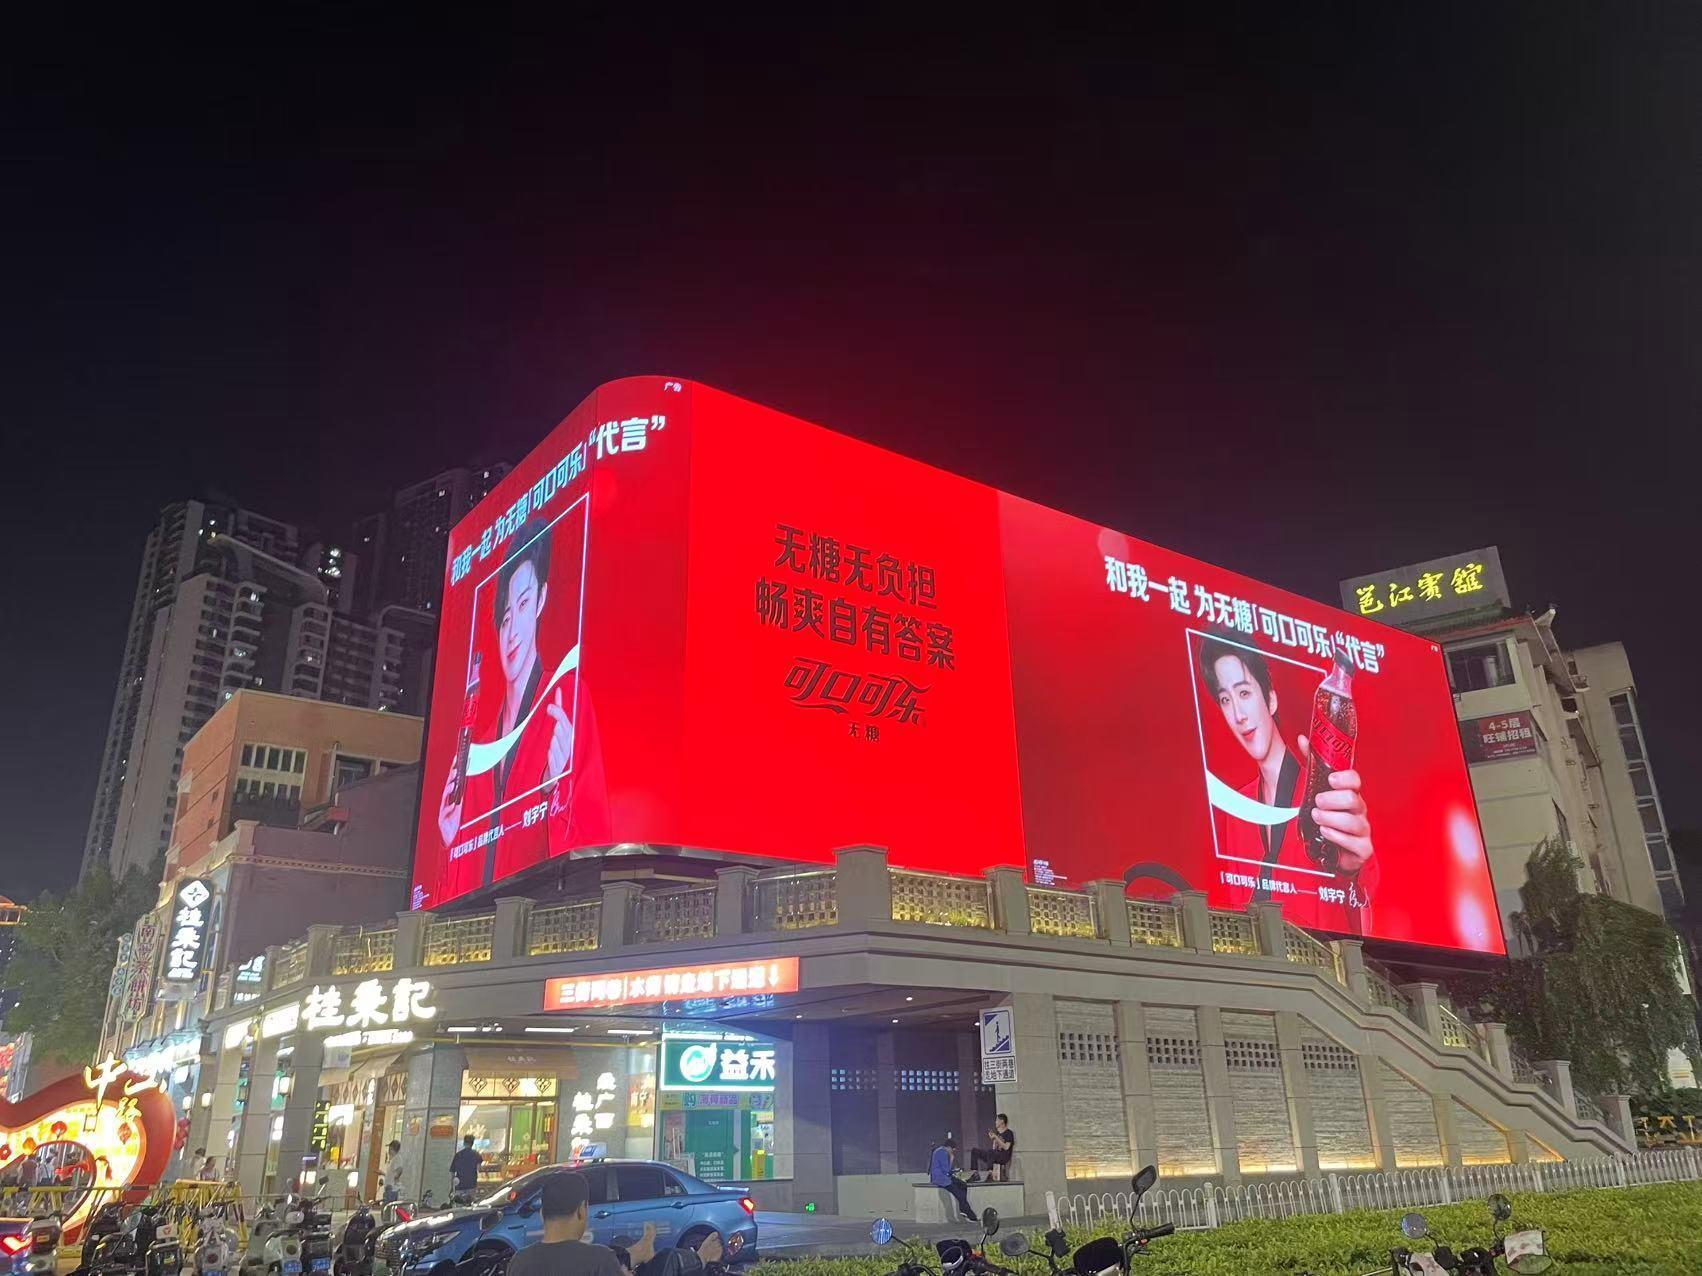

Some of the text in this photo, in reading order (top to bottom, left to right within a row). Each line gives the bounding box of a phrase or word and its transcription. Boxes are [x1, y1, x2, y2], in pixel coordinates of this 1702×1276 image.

[451, 525, 493, 586] 和我一起
[774, 523, 938, 610] 无糖无负担
[1104, 556, 1191, 615] 和我一起
[755, 576, 956, 671] 畅爽自有答案
[784, 656, 934, 726] 可口可乐
[848, 722, 880, 741] 无糖
[1482, 727, 1532, 744] 旺铺招租
[1489, 717, 1521, 731] 4-5层
[719, 1050, 776, 1080] 益禾
